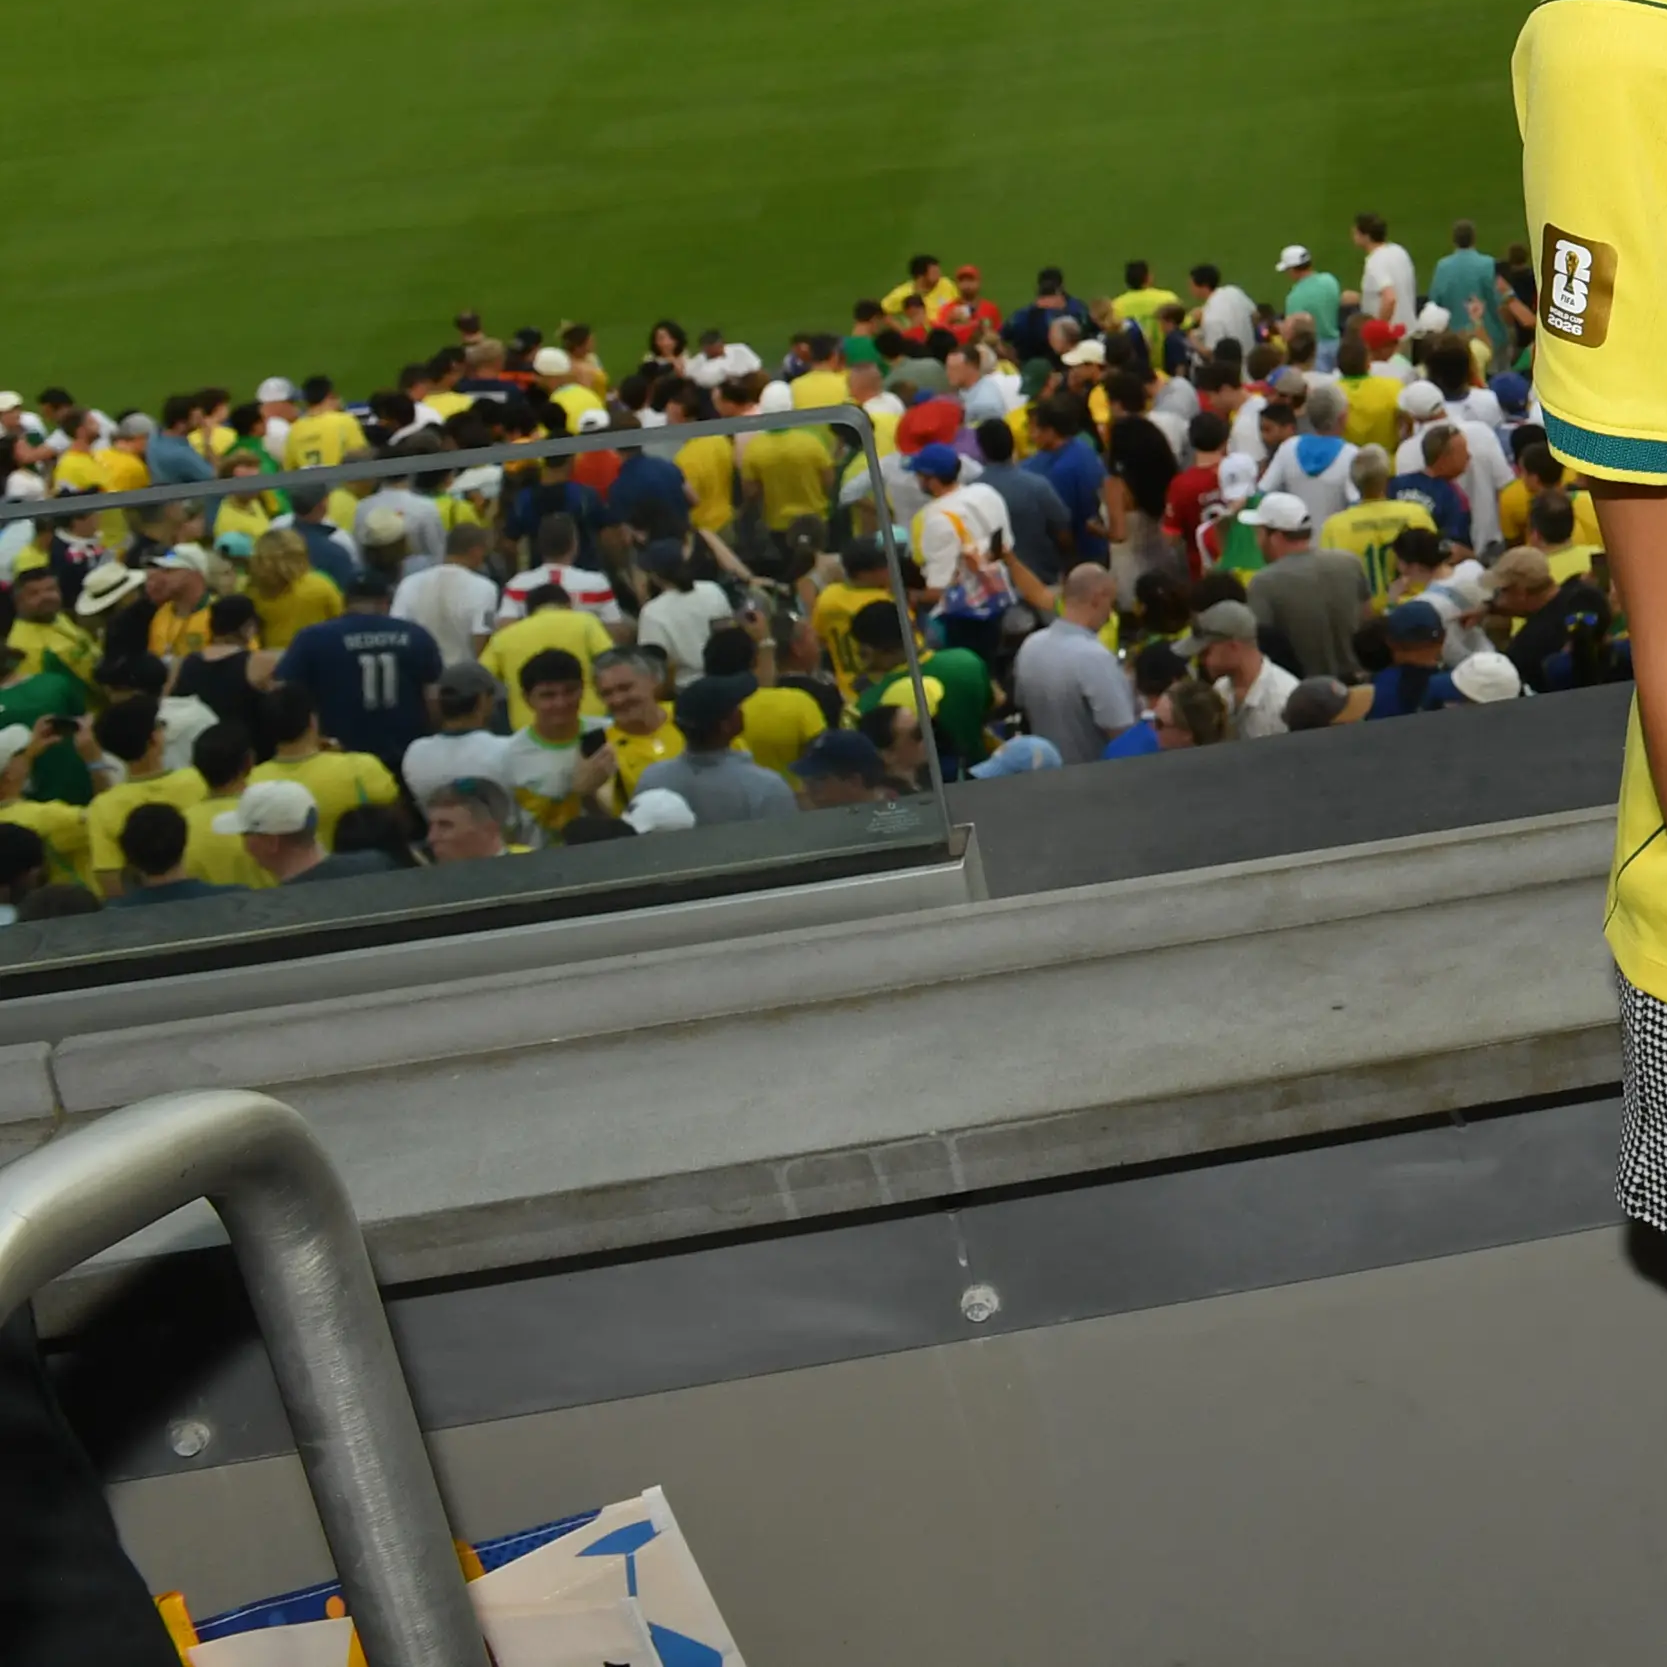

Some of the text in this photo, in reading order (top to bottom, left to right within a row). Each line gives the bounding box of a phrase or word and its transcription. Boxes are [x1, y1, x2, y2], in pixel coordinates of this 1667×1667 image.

[1561, 294, 1575, 307] FIFA
[1548, 314, 1583, 336] 2026
[1570, 314, 1584, 324] CUP
[358, 653, 396, 710] 11
